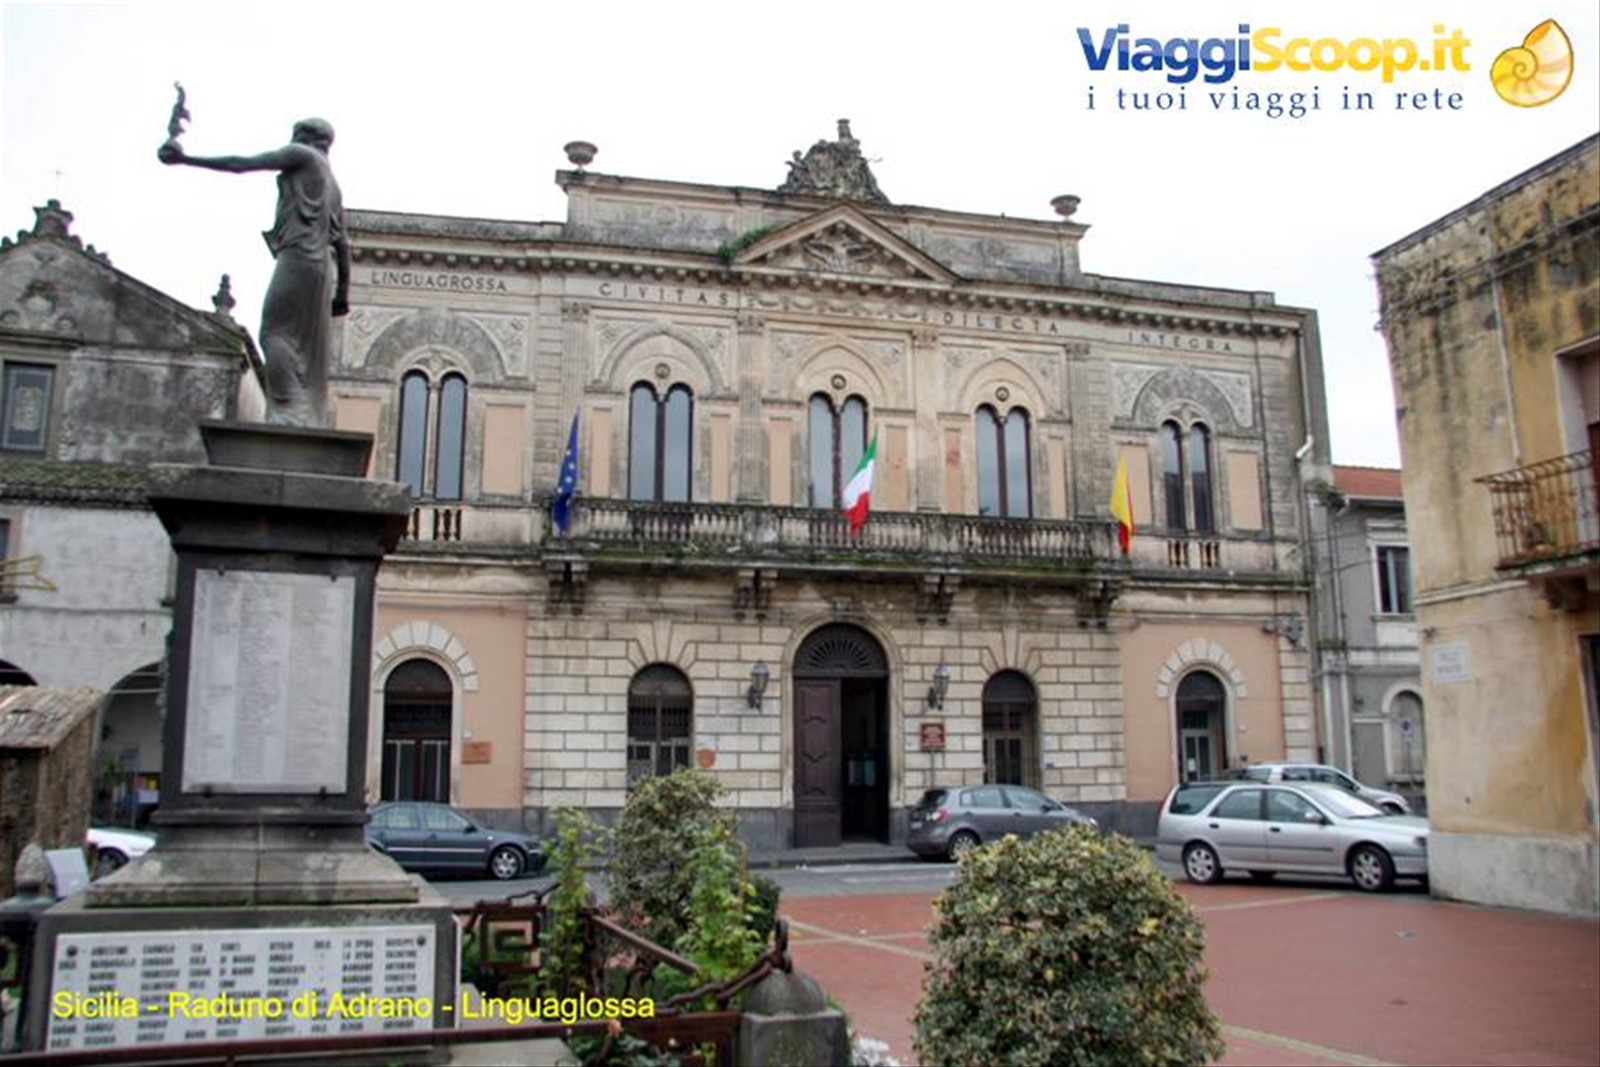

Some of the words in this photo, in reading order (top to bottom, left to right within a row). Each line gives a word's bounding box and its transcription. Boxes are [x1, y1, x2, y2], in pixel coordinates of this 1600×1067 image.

[599, 282, 729, 305] CIVITAS
[942, 312, 1060, 334] DILECTA
[1128, 331, 1232, 352] INTEGRA
